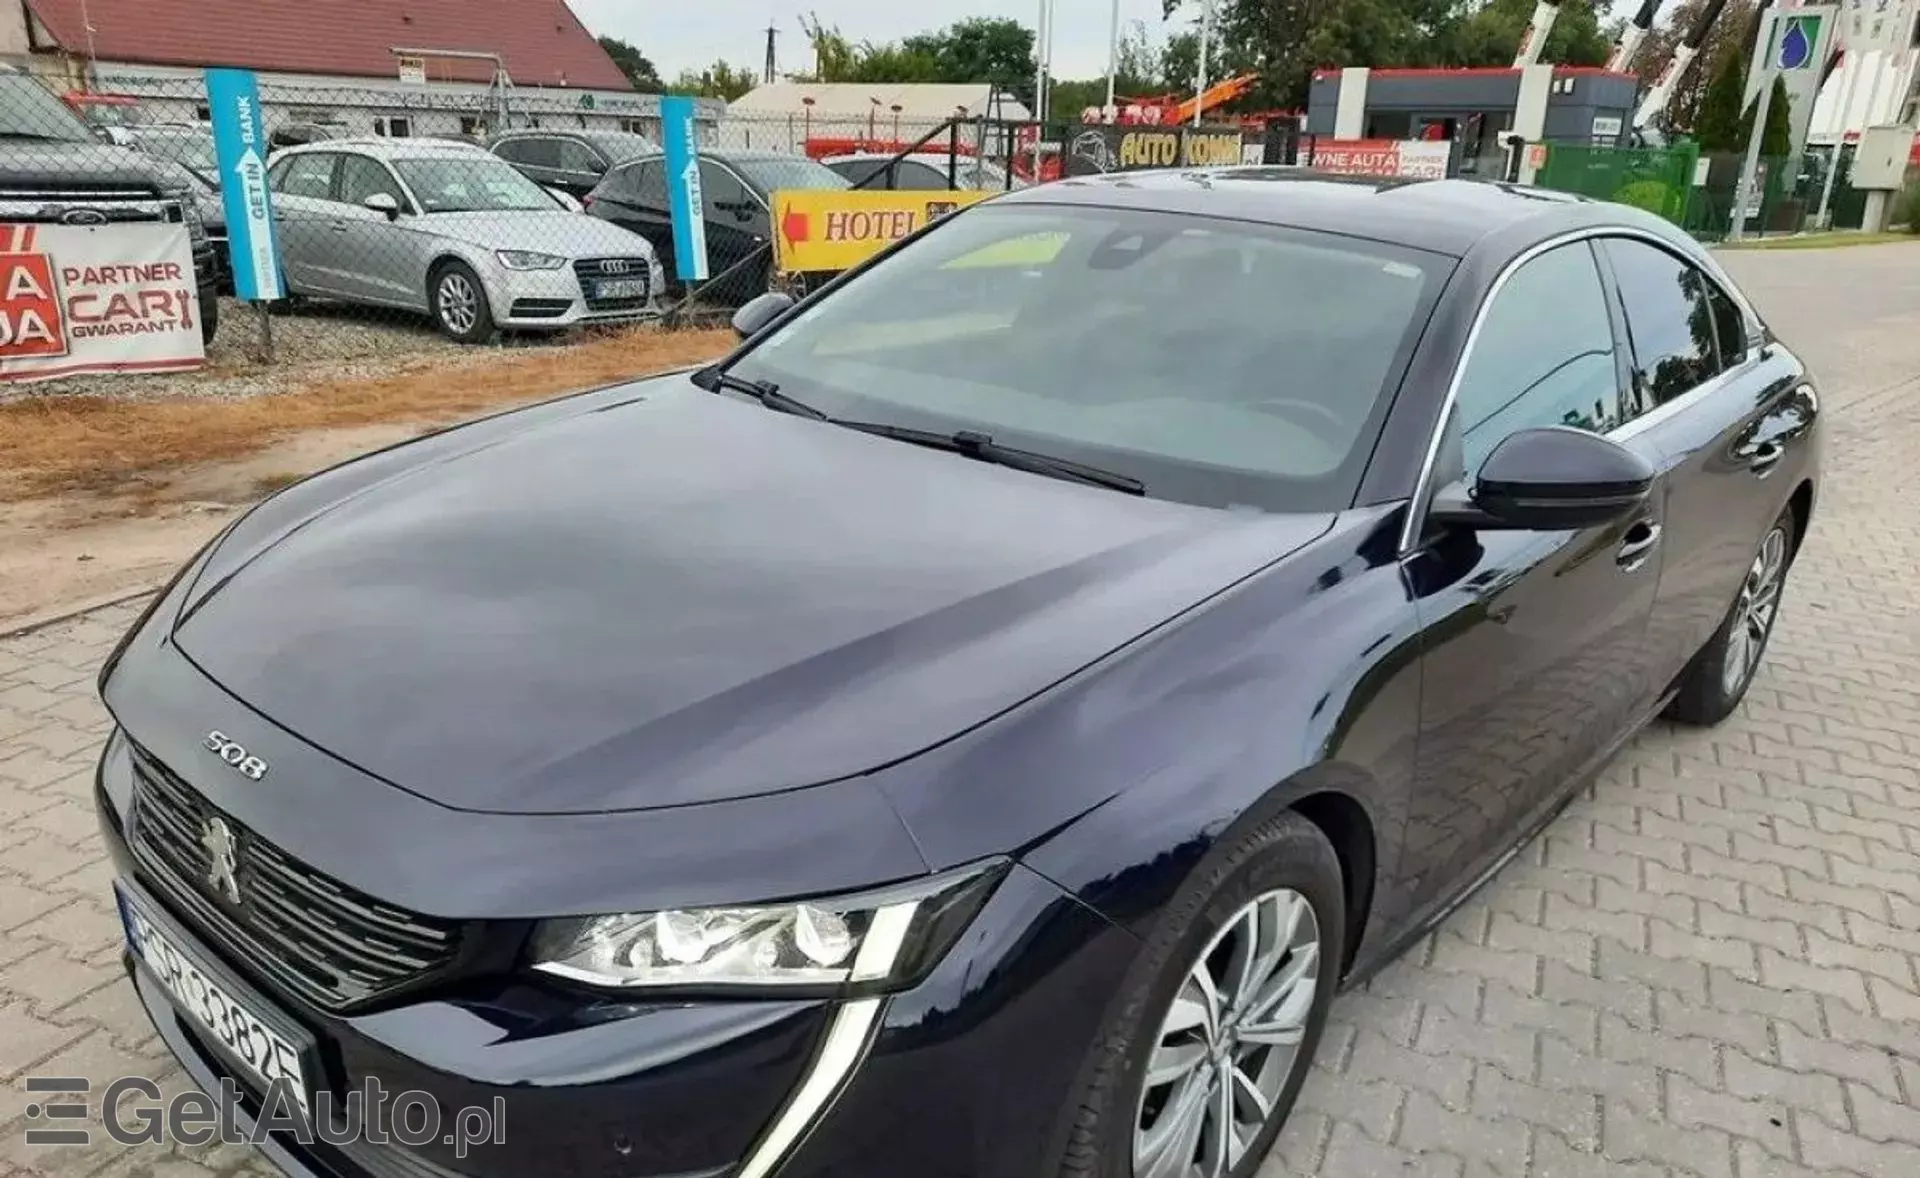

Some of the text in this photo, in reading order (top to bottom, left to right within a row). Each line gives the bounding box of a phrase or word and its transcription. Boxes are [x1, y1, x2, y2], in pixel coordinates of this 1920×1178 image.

[237, 95, 266, 220] GET IN BANK
[1120, 132, 1177, 168] AUTO
[1350, 152, 1397, 168] AUTA
[62, 263, 182, 287] PARTNER
[67, 290, 175, 323] CAR
[72, 319, 178, 338] GWARANT
[202, 729, 269, 781] 508
